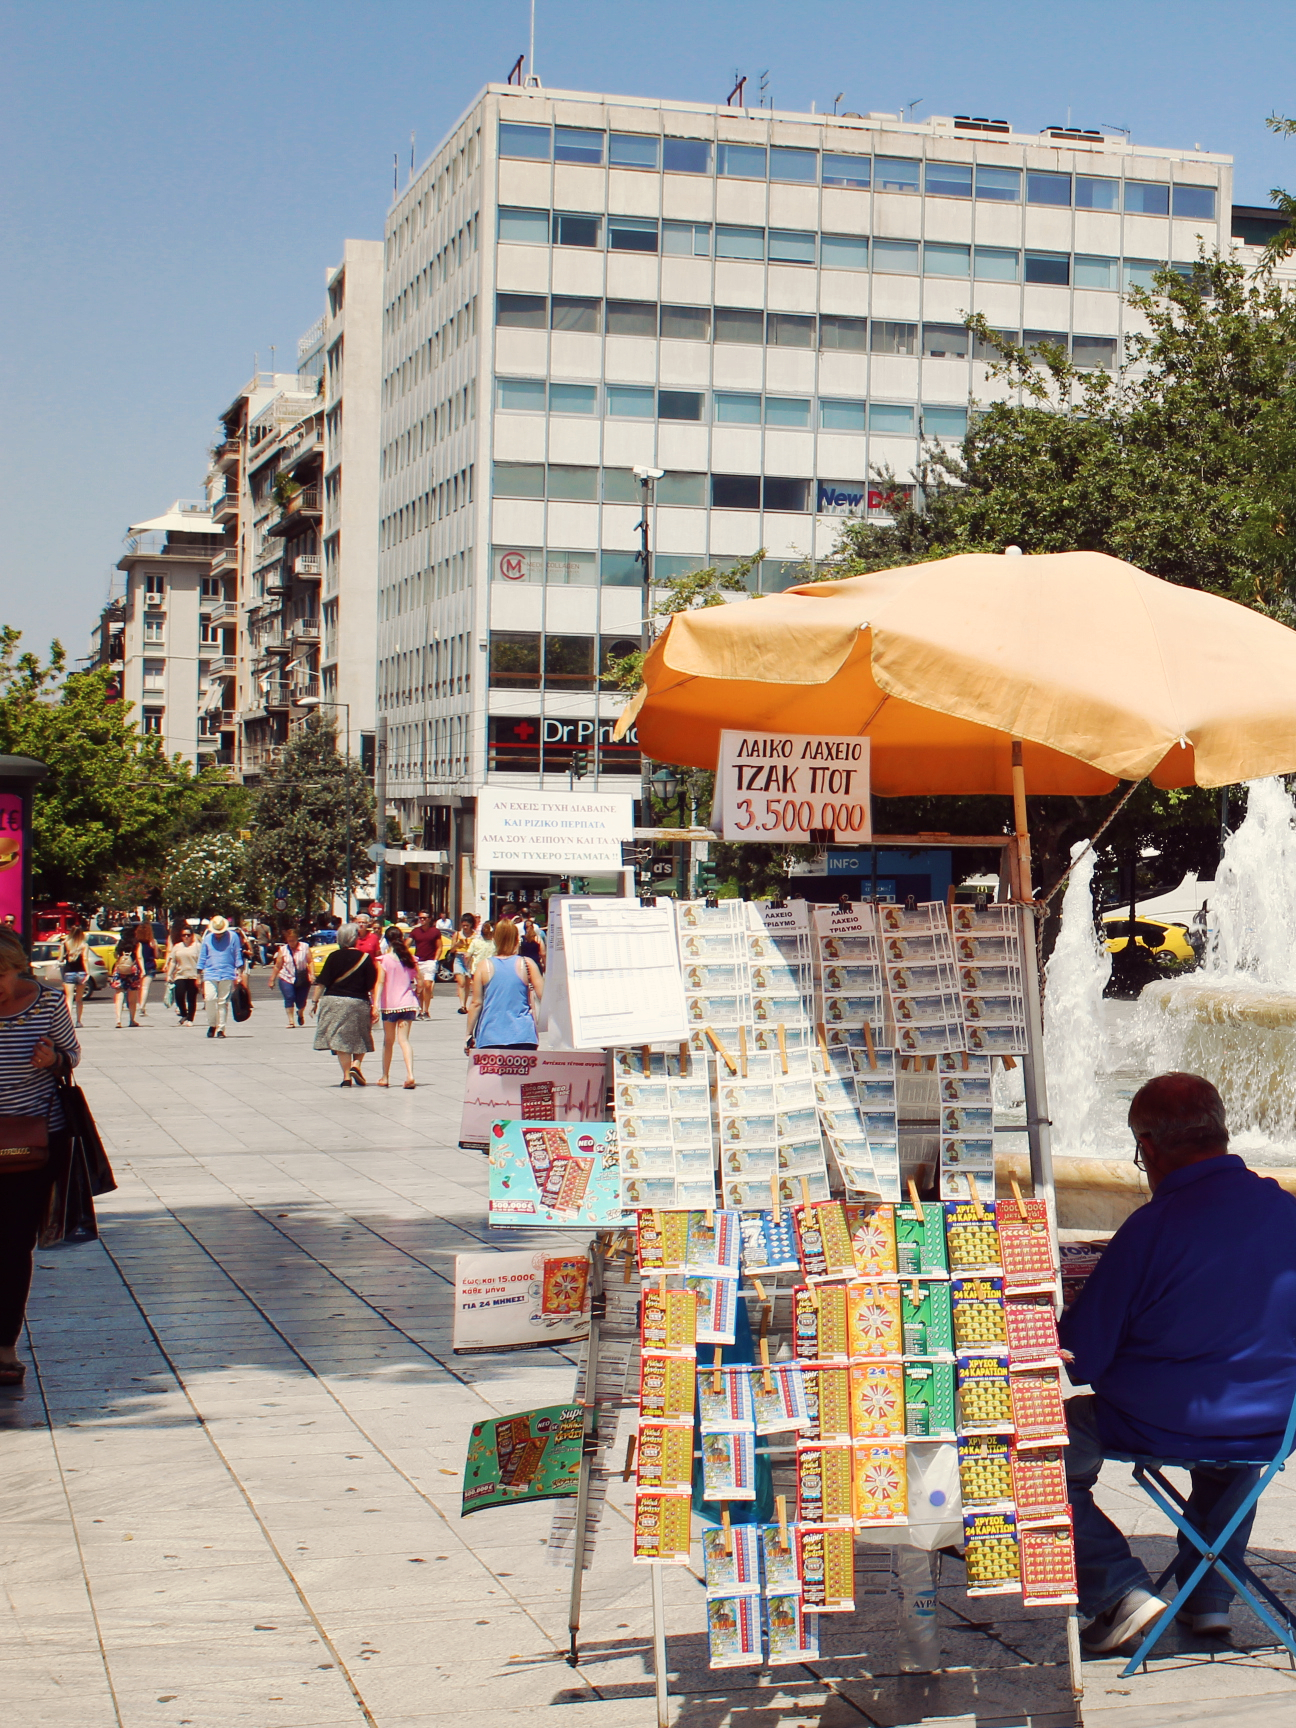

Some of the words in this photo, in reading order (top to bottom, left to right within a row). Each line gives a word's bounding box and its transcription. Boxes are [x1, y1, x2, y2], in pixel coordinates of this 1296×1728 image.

[819, 487, 864, 507] New
[544, 719, 574, 742] Dr
[737, 738, 793, 758] ΛΑΙΚΟ
[800, 740, 862, 761] ΛΑΧΕΙΟ
[732, 764, 799, 793] ΤΖΑΚ
[809, 766, 857, 795] ΠΟΤ
[493, 802, 507, 810] ΑΝ
[510, 802, 539, 811] ΕΧΕΙΣ
[542, 803, 568, 812] ΤΥΧΗ
[570, 804, 616, 813] ΔΙΑΒΑΙΝΕ
[504, 818, 522, 827] ΚΑΙ
[525, 819, 558, 828] ΡΙΖΙΚΟ
[561, 820, 606, 829] ΠΕΡΠΑΤΑ
[482, 834, 504, 843] ΑΜΑ
[506, 835, 527, 843] ΣΟΥ
[528, 836, 573, 844] ΛΕΙΠΟΥΝ
[597, 837, 608, 845] ΤΑ
[492, 850, 520, 860] ΣΤΟΝ
[522, 851, 562, 860] ΤΥΧΕΡΟ
[564, 852, 610, 861] ΣΤΑΜΑΤΑ
[830, 859, 859, 868] INFO
[763, 920, 796, 928] ΤΡΙΔΥΜΟ
[832, 917, 859, 925] ΛΑΧΕΙΟ
[829, 925, 862, 934] ΤΡΙΔΥΜΟ
[474, 1054, 538, 1067] 1.000.000€
[480, 1065, 530, 1075] μετρητά!
[551, 1085, 566, 1093] ΝΕΟ
[578, 1138, 594, 1147] ΝΕΟ
[492, 1201, 533, 1209] 500.000€
[947, 1214, 957, 1222] 24
[462, 1277, 480, 1286] έως
[498, 1273, 535, 1283] 15.000€
[462, 1287, 482, 1295] κάθε
[485, 1286, 506, 1295] μήνα
[953, 1291, 962, 1299] 24
[462, 1302, 476, 1310] ΓΙΑ
[493, 1295, 525, 1306] ΜΗΝΕΣ!
[969, 1359, 998, 1368] ΧΡΥΣΟΣ
[960, 1369, 969, 1377] 24
[970, 1367, 1007, 1377] ΚΑΡΑΤΙΩΝ
[537, 1420, 551, 1429] ΝΕΟ
[872, 1448, 890, 1456] 24
[959, 1447, 968, 1455] 24
[974, 1516, 1005, 1526] ΧΡΥΣΟΣ
[965, 1526, 975, 1536] 24
[975, 1524, 1015, 1535] ΚΑΡΑΤΙΩΝ
